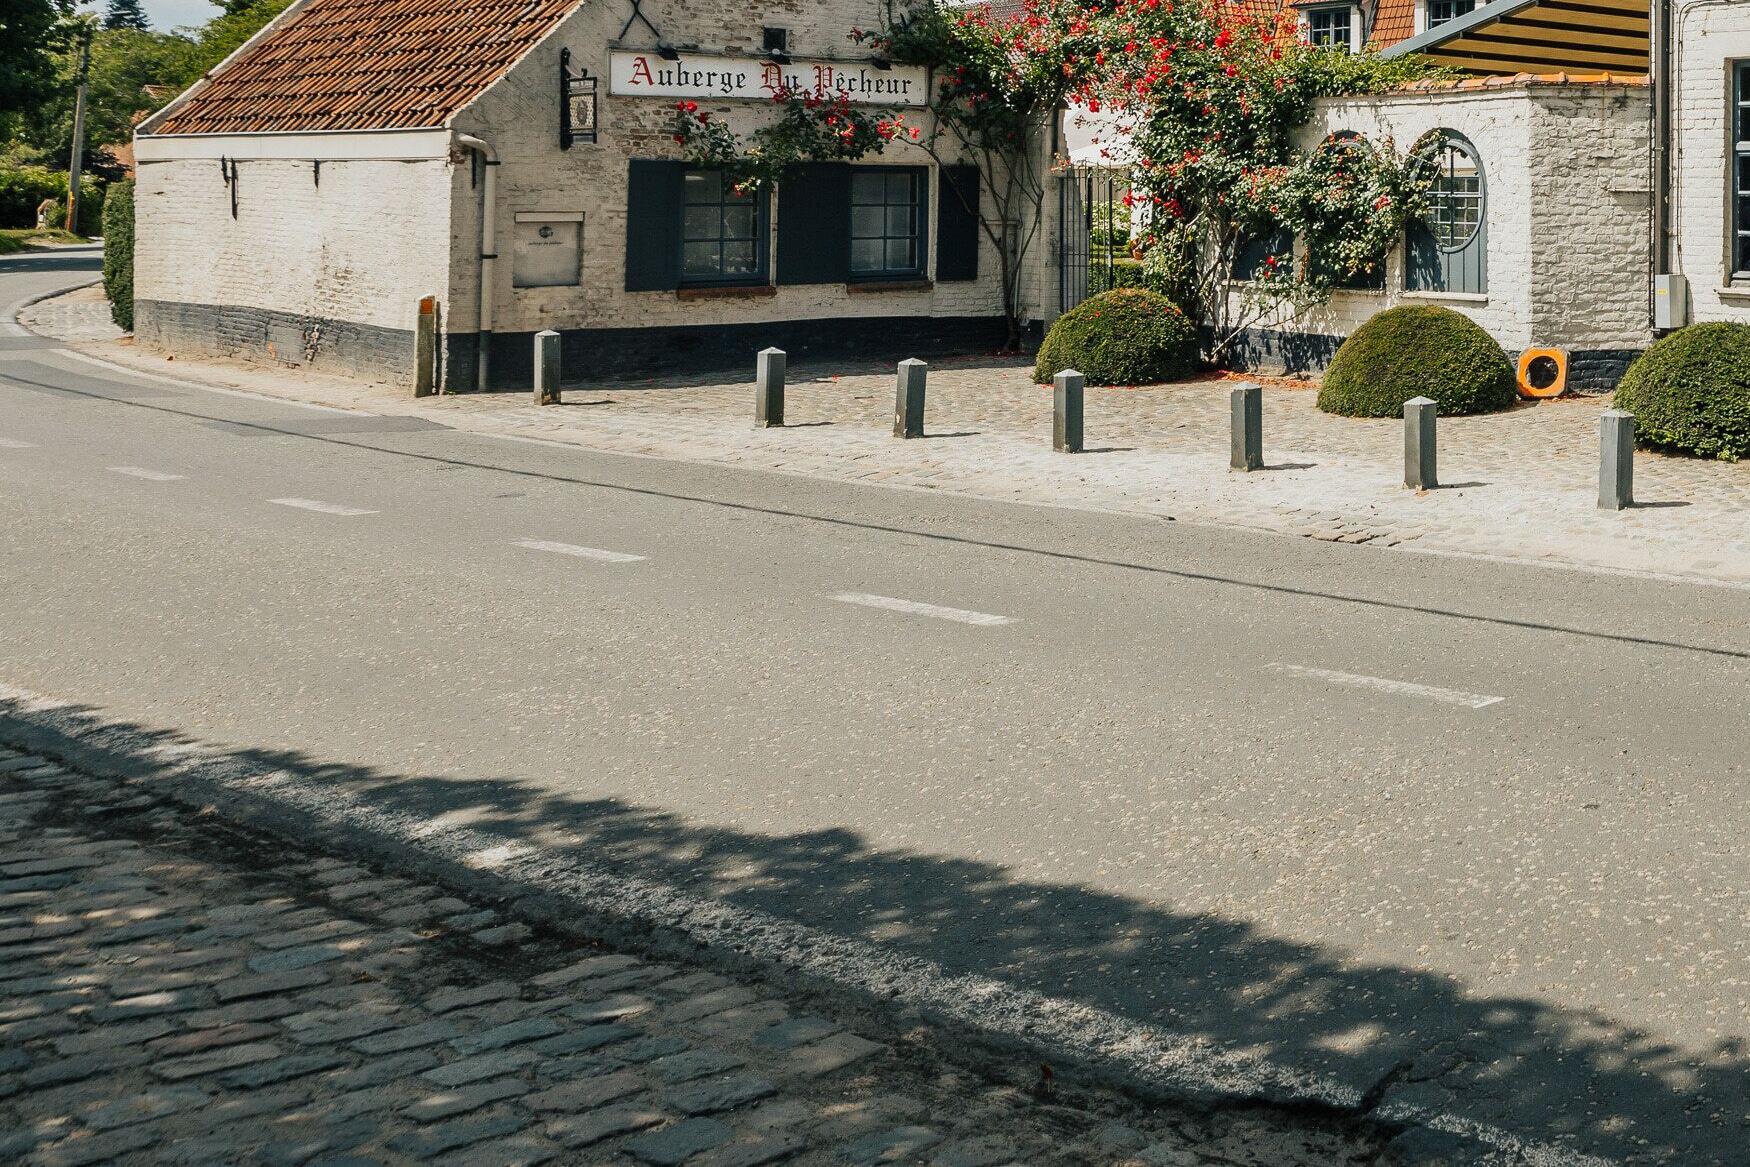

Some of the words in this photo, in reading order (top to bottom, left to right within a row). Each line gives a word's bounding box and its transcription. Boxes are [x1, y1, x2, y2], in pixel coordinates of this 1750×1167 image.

[628, 56, 746, 94] Auberge
[759, 61, 799, 91] Du
[813, 64, 912, 99] Pêcheur
